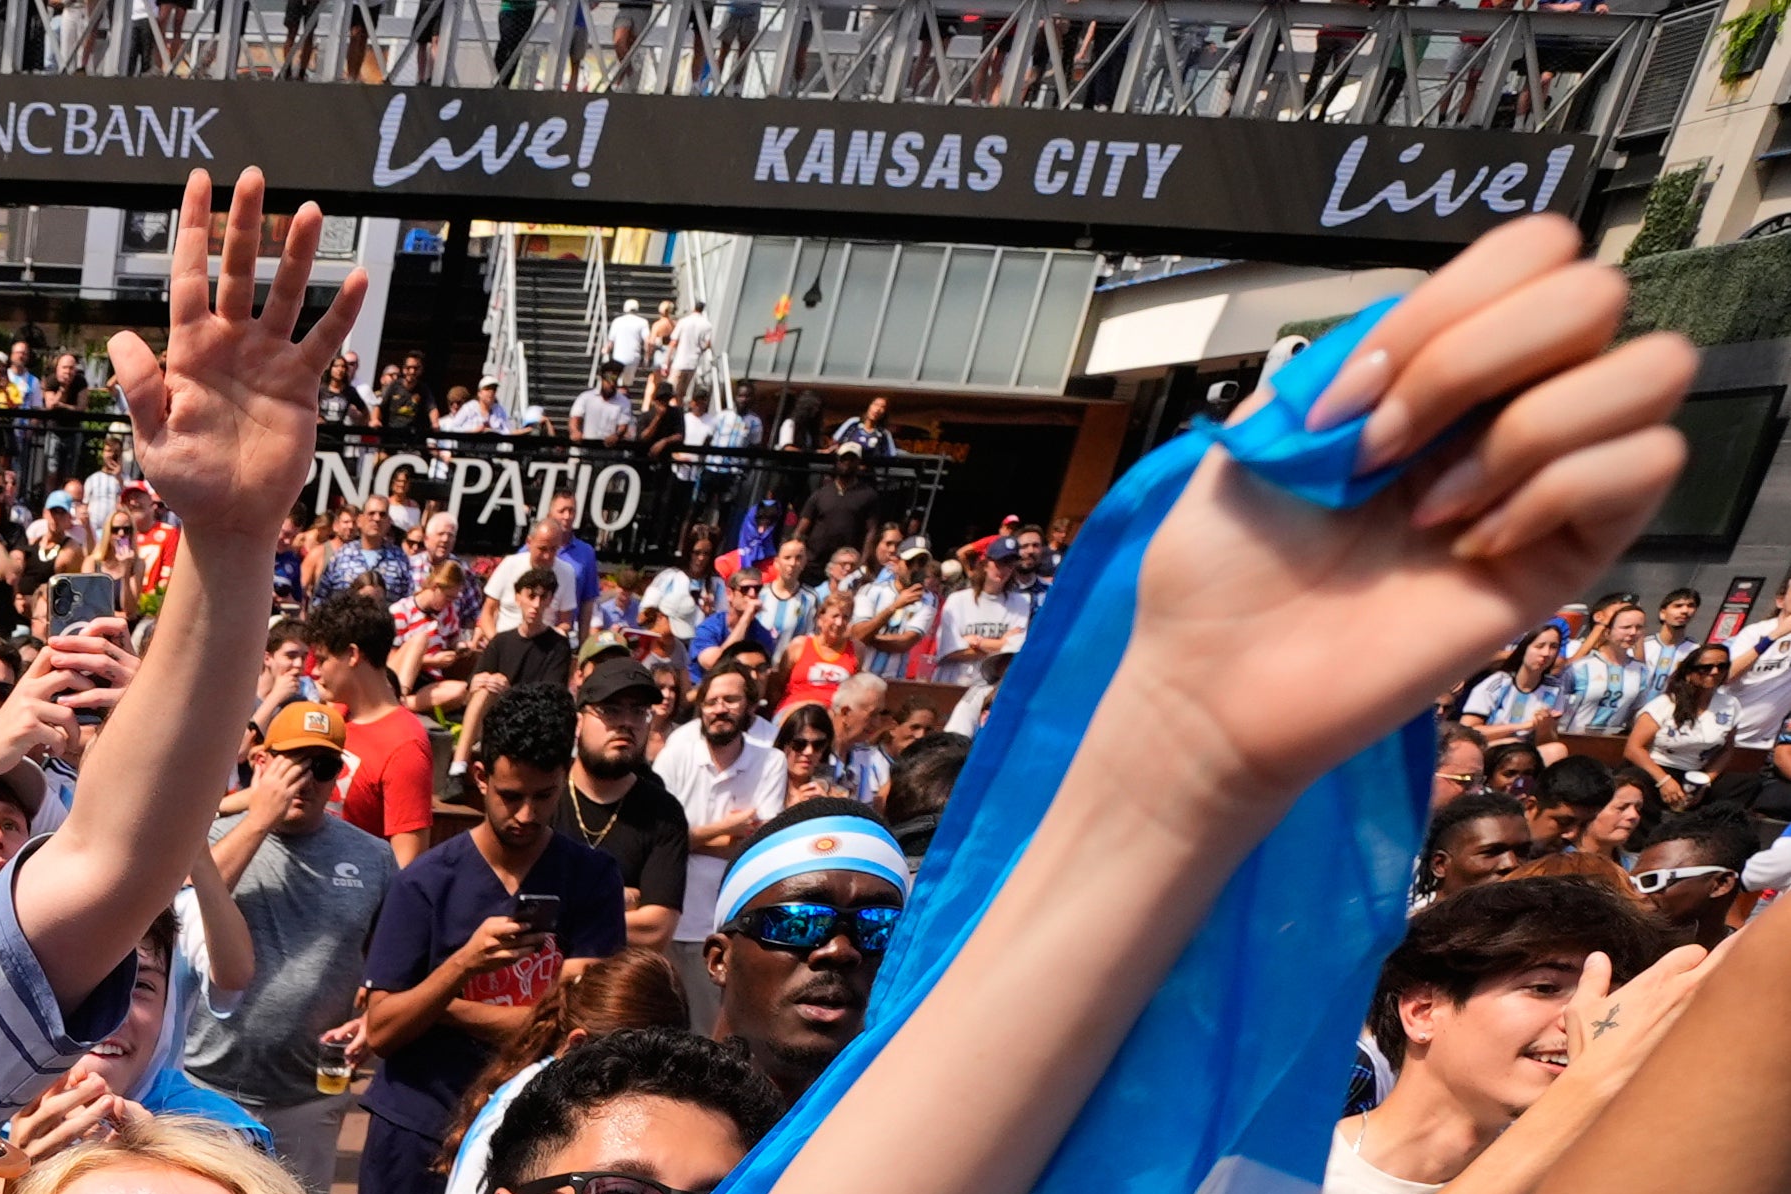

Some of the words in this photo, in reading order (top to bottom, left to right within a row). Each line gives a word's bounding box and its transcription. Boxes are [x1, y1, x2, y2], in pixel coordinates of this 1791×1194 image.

[60, 103, 220, 159] BANK
[373, 93, 609, 187] Live!
[755, 126, 1008, 192] KANSAS
[1033, 137, 1183, 200] CITY
[305, 451, 430, 516] NC
[448, 457, 642, 531] PATIO
[1598, 690, 1623, 709] 22
[332, 877, 364, 889] COSTA
